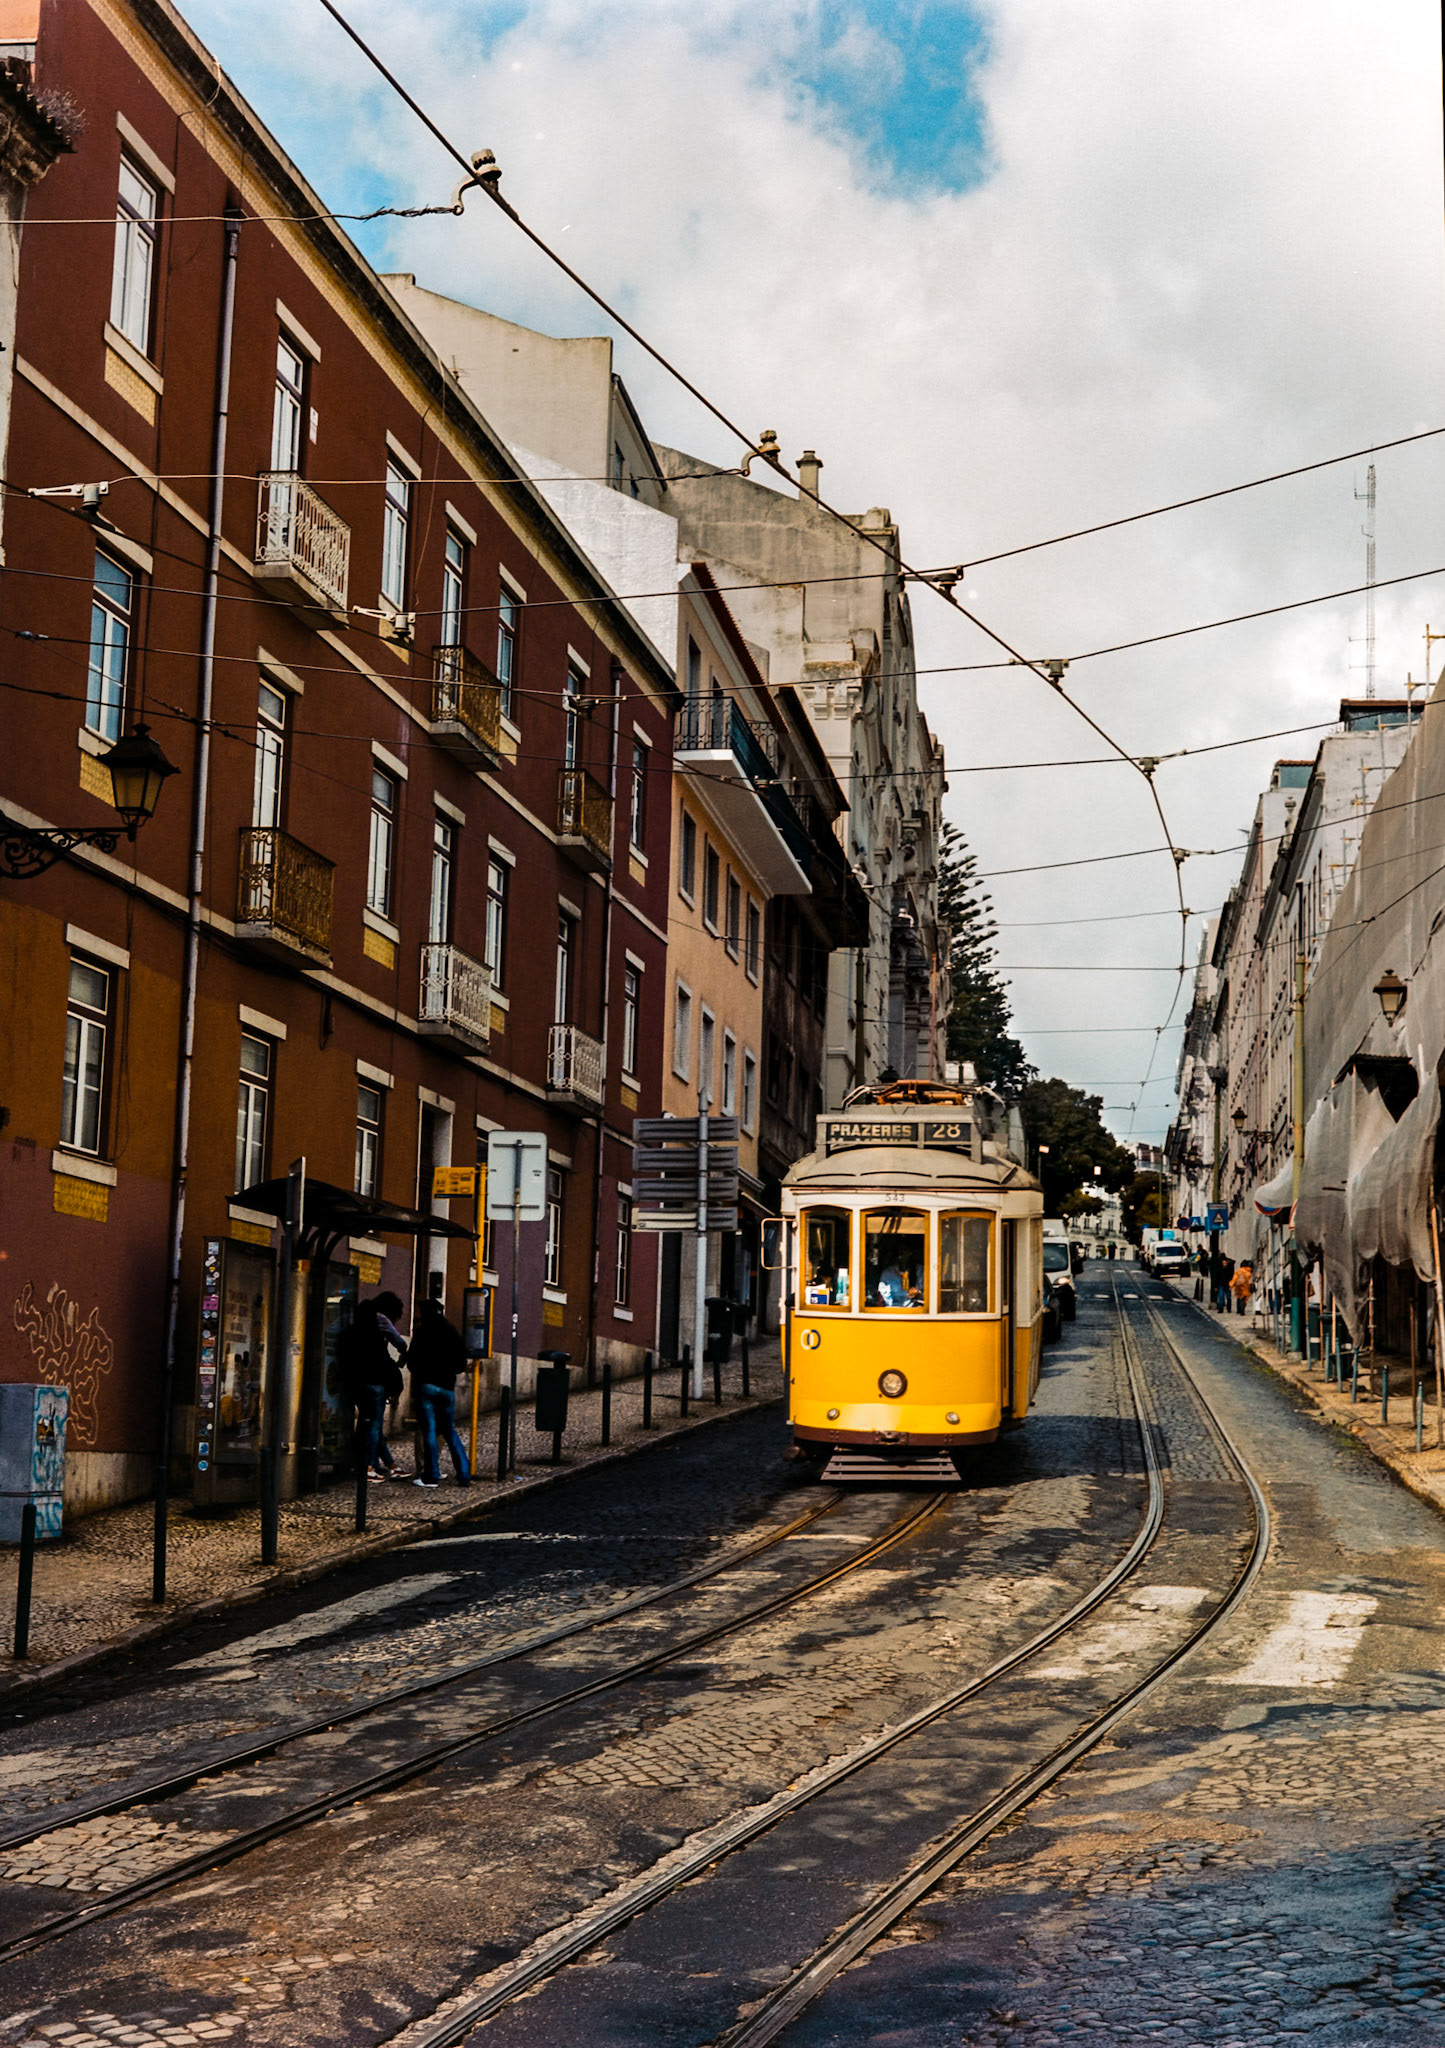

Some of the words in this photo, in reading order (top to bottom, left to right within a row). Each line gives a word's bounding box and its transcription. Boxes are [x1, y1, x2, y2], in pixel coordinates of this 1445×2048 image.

[830, 1124, 912, 1137] PRAZERES
[932, 1124, 961, 1139] 28
[885, 1193, 905, 1202] 543
